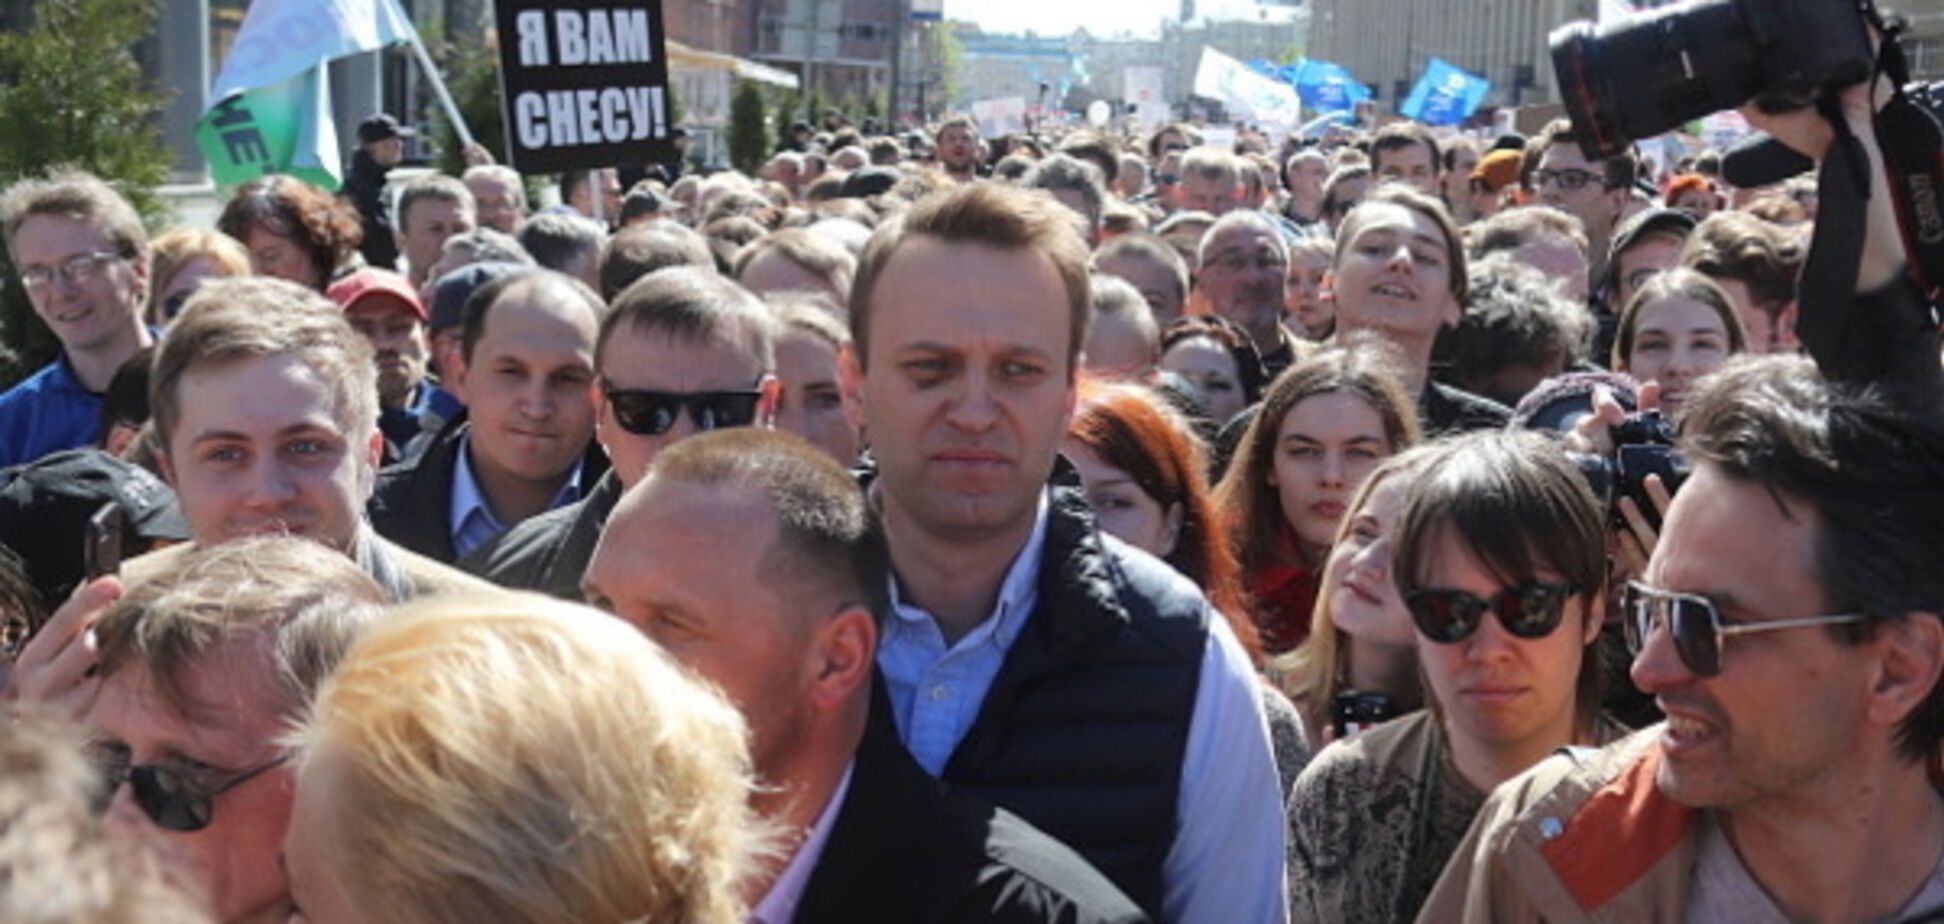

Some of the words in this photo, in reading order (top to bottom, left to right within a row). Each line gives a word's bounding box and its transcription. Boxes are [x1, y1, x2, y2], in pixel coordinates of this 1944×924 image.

[516, 9, 550, 67] Я
[555, 9, 651, 66] ВАМ
[515, 86, 667, 149] СНЕСУ!
